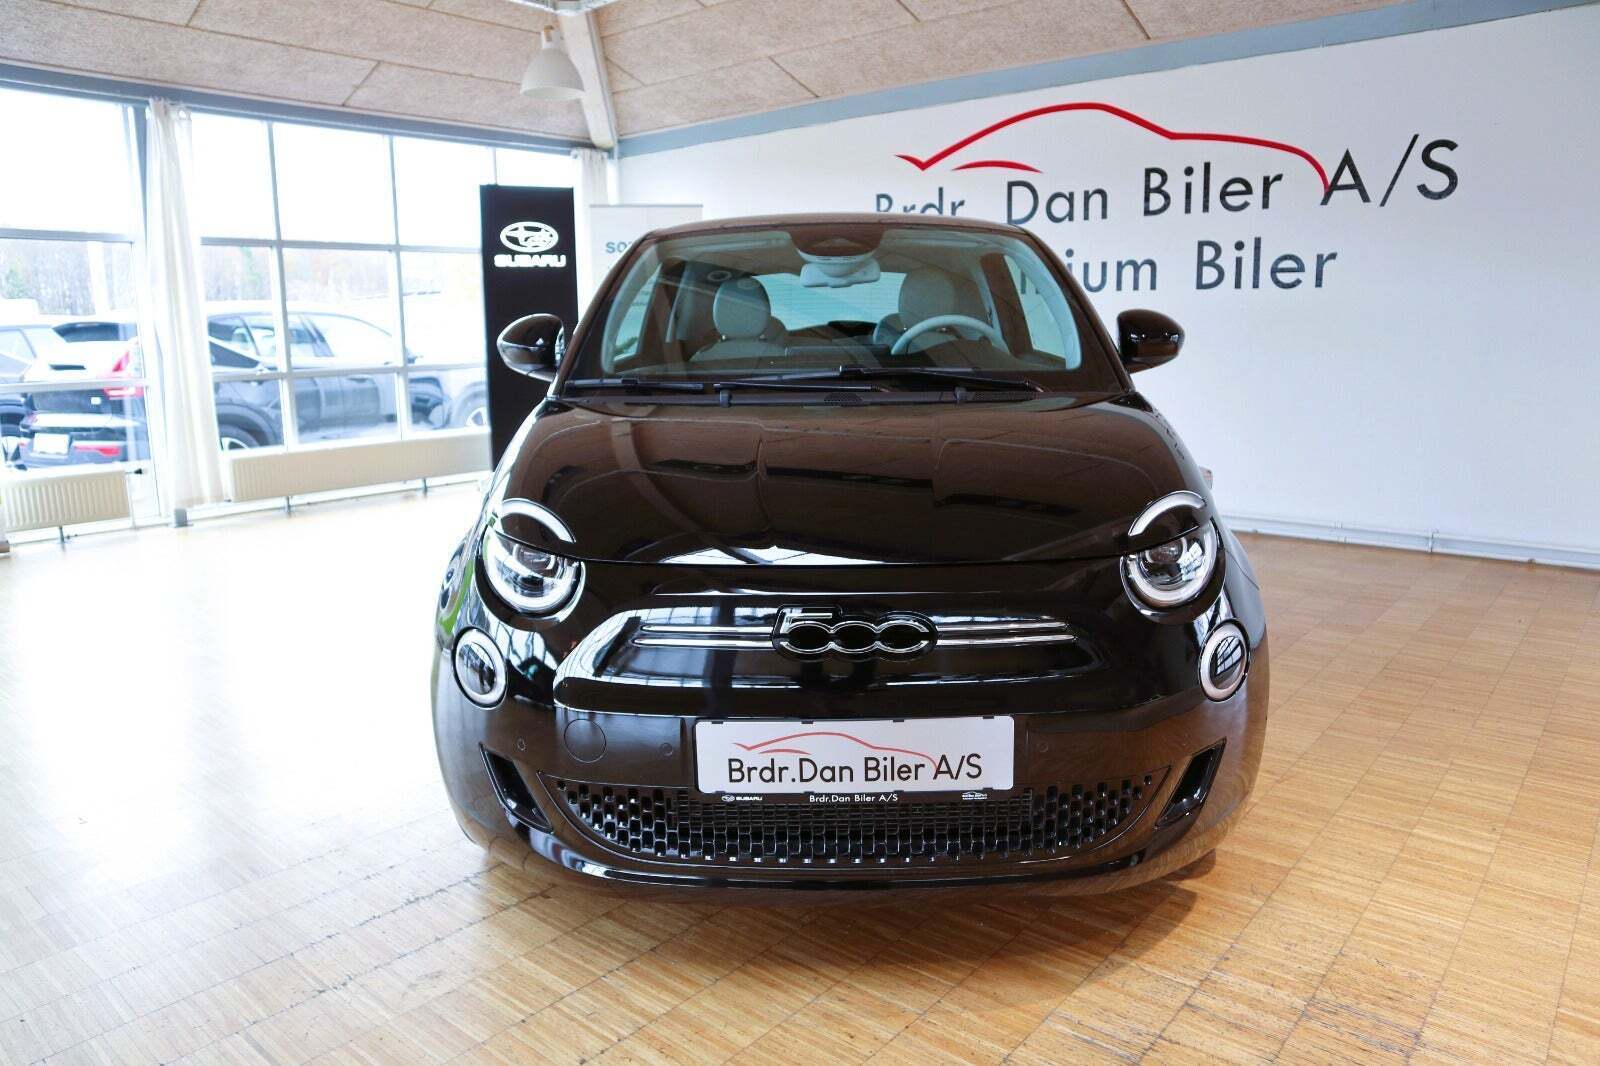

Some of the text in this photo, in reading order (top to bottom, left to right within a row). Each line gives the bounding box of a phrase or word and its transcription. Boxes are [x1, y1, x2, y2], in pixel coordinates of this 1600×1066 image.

[1006, 179, 1108, 225] Dan
[1143, 161, 1284, 217] Biler
[1320, 133, 1459, 208] A/S
[494, 254, 567, 268] SUBARU
[1196, 236, 1338, 290] Biler
[772, 606, 936, 660] 500
[728, 753, 983, 783] Brdr.Dan Biler A/S
[854, 793, 876, 803] Biler
[878, 793, 898, 802] A/S
